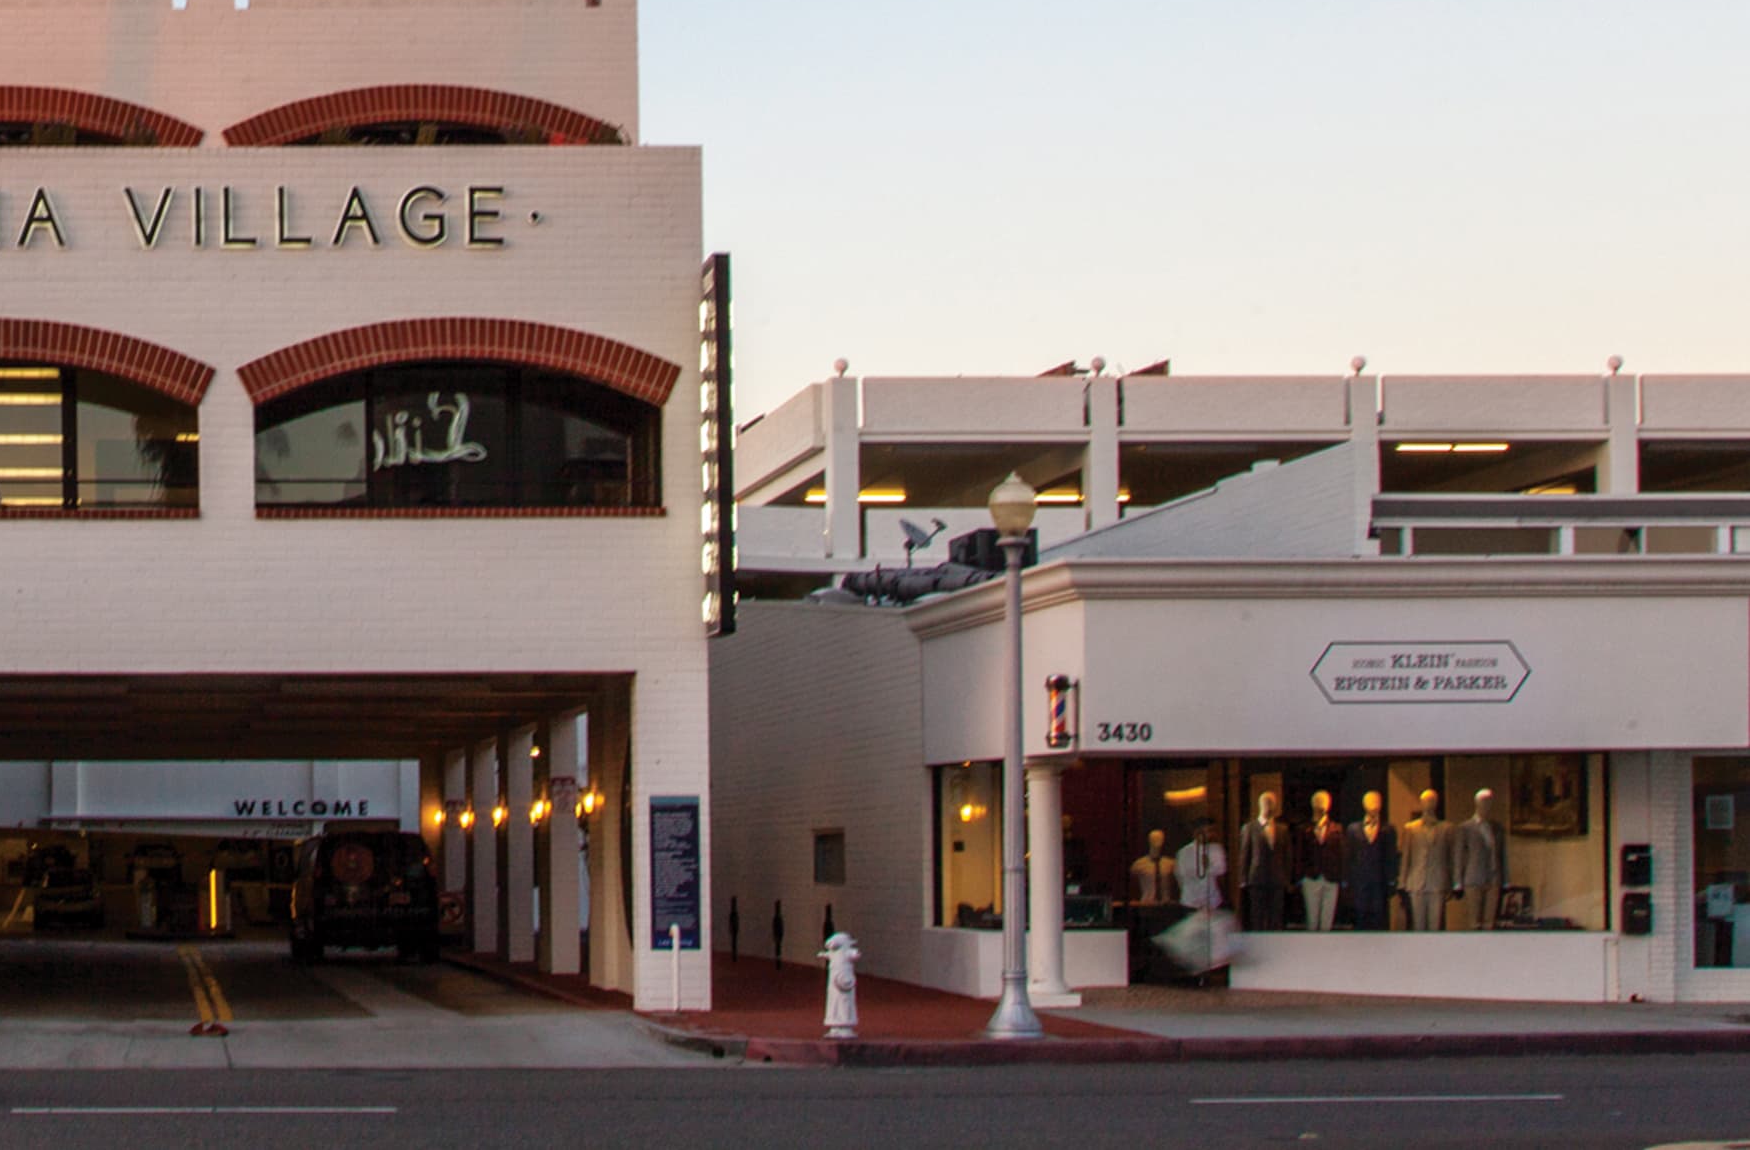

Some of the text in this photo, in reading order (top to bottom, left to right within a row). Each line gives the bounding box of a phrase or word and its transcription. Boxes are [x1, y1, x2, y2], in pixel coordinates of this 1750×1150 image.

[123, 185, 507, 248] VILLAGE
[1333, 675, 1508, 691] EPSTEIN & PARKER
[1096, 721, 1153, 743] 3430
[234, 800, 369, 816] WELCOME
